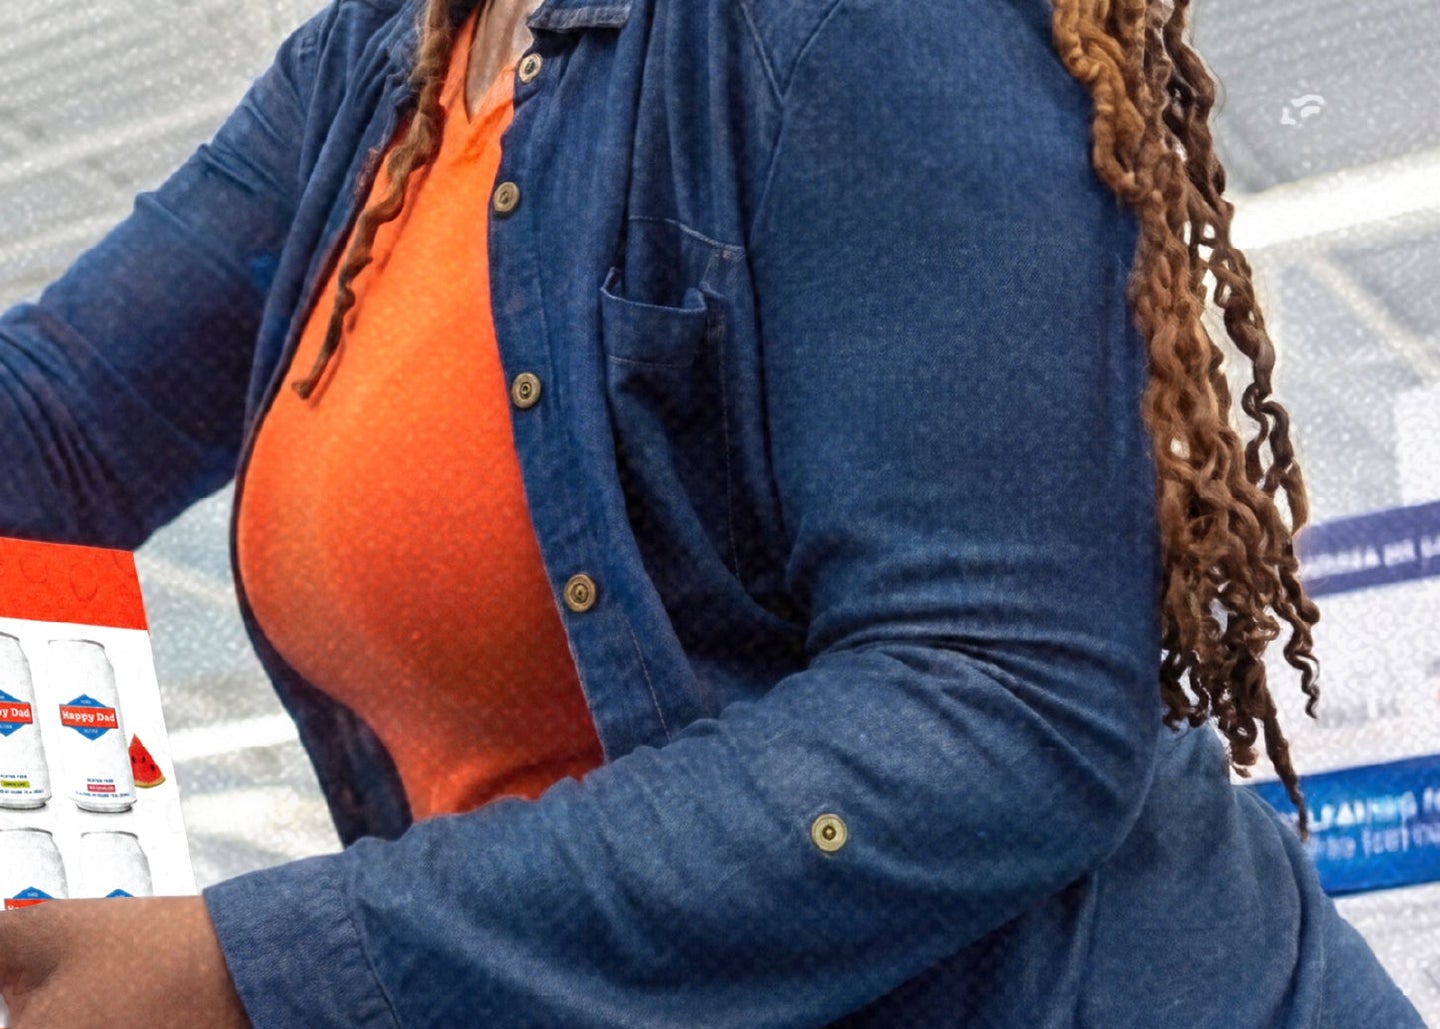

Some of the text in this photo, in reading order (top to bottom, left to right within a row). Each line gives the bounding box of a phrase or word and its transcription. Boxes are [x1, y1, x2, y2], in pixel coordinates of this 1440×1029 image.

[11, 707, 31, 718] Dad
[62, 711, 116, 723] Happy Dad
